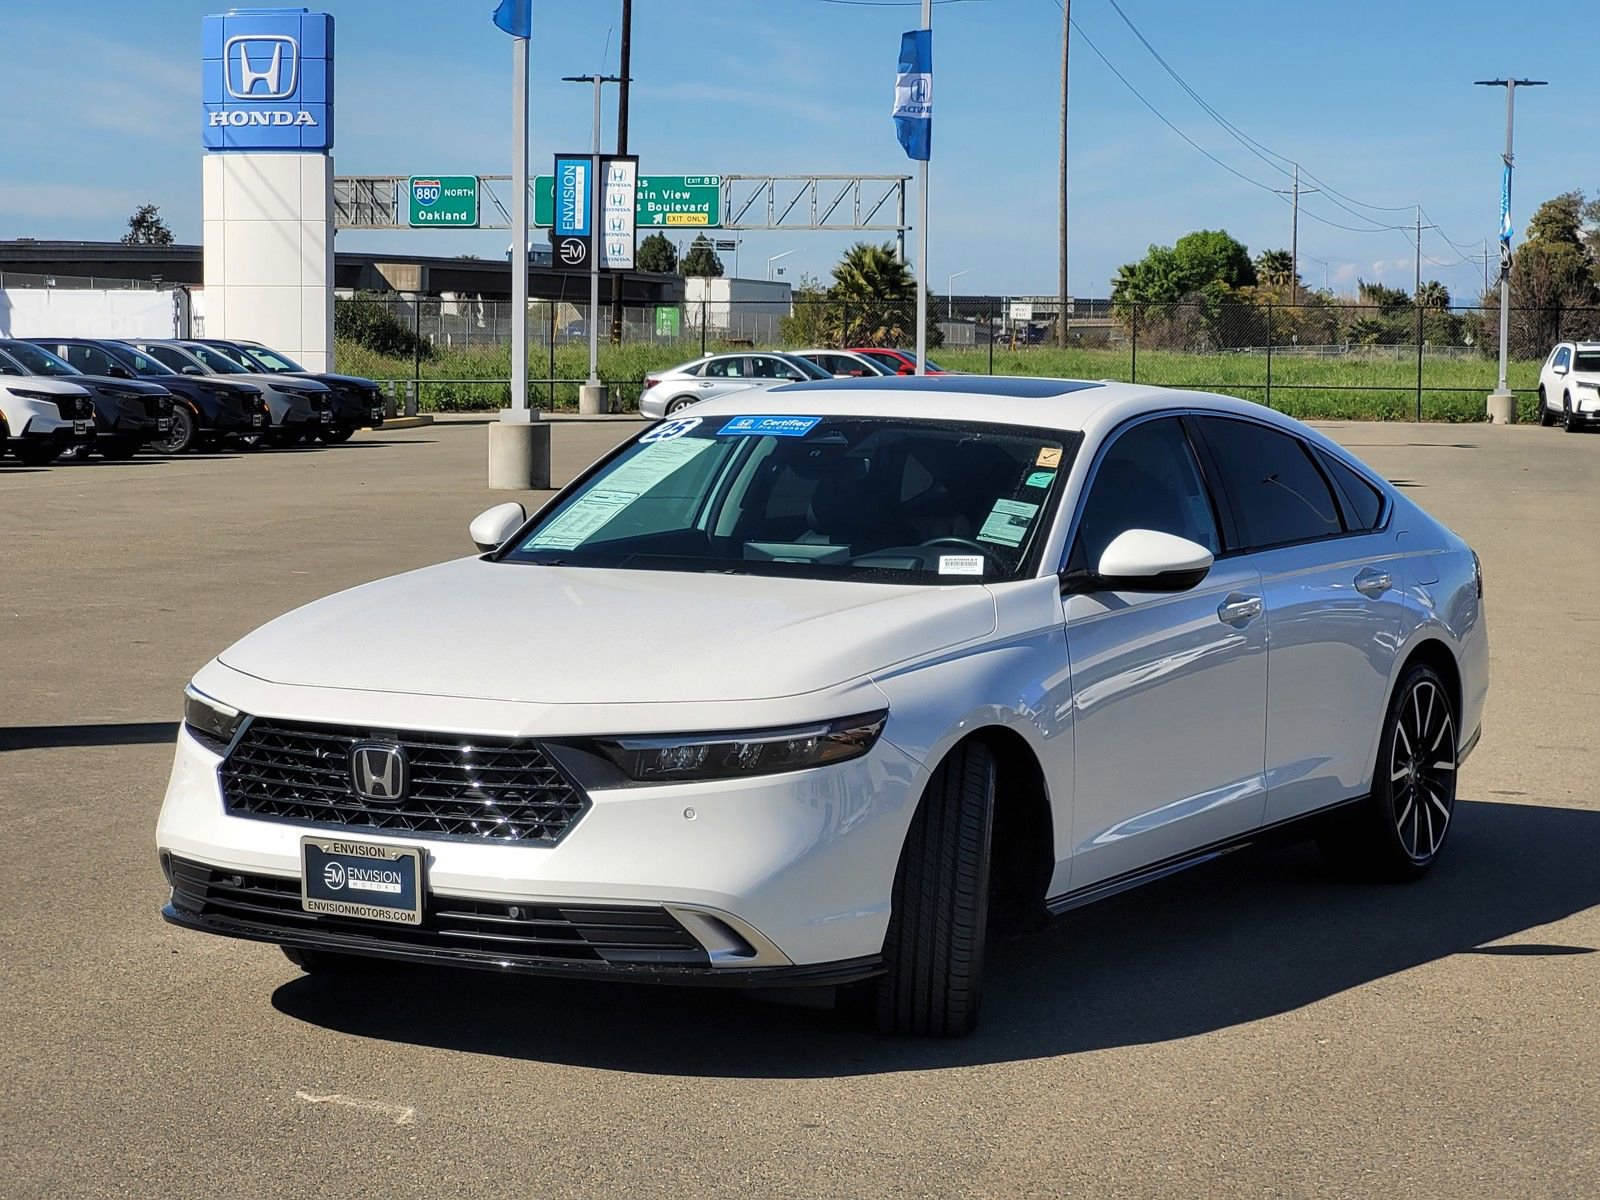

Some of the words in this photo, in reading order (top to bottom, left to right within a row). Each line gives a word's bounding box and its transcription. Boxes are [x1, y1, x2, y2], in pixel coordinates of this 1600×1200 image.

[208, 110, 318, 127] HONDA
[416, 188, 438, 200] 880
[444, 188, 474, 197] NORTH
[562, 165, 576, 230] ENVISION
[662, 189, 691, 200] View
[647, 202, 709, 212] Boulevard
[418, 210, 467, 221] Oakland
[762, 418, 814, 427] Certified
[333, 842, 386, 858] ENVISION
[347, 867, 402, 884] ENVISION
[352, 881, 397, 891] MOTORS
[308, 900, 416, 922] ENVISIONMOTORS.COM
